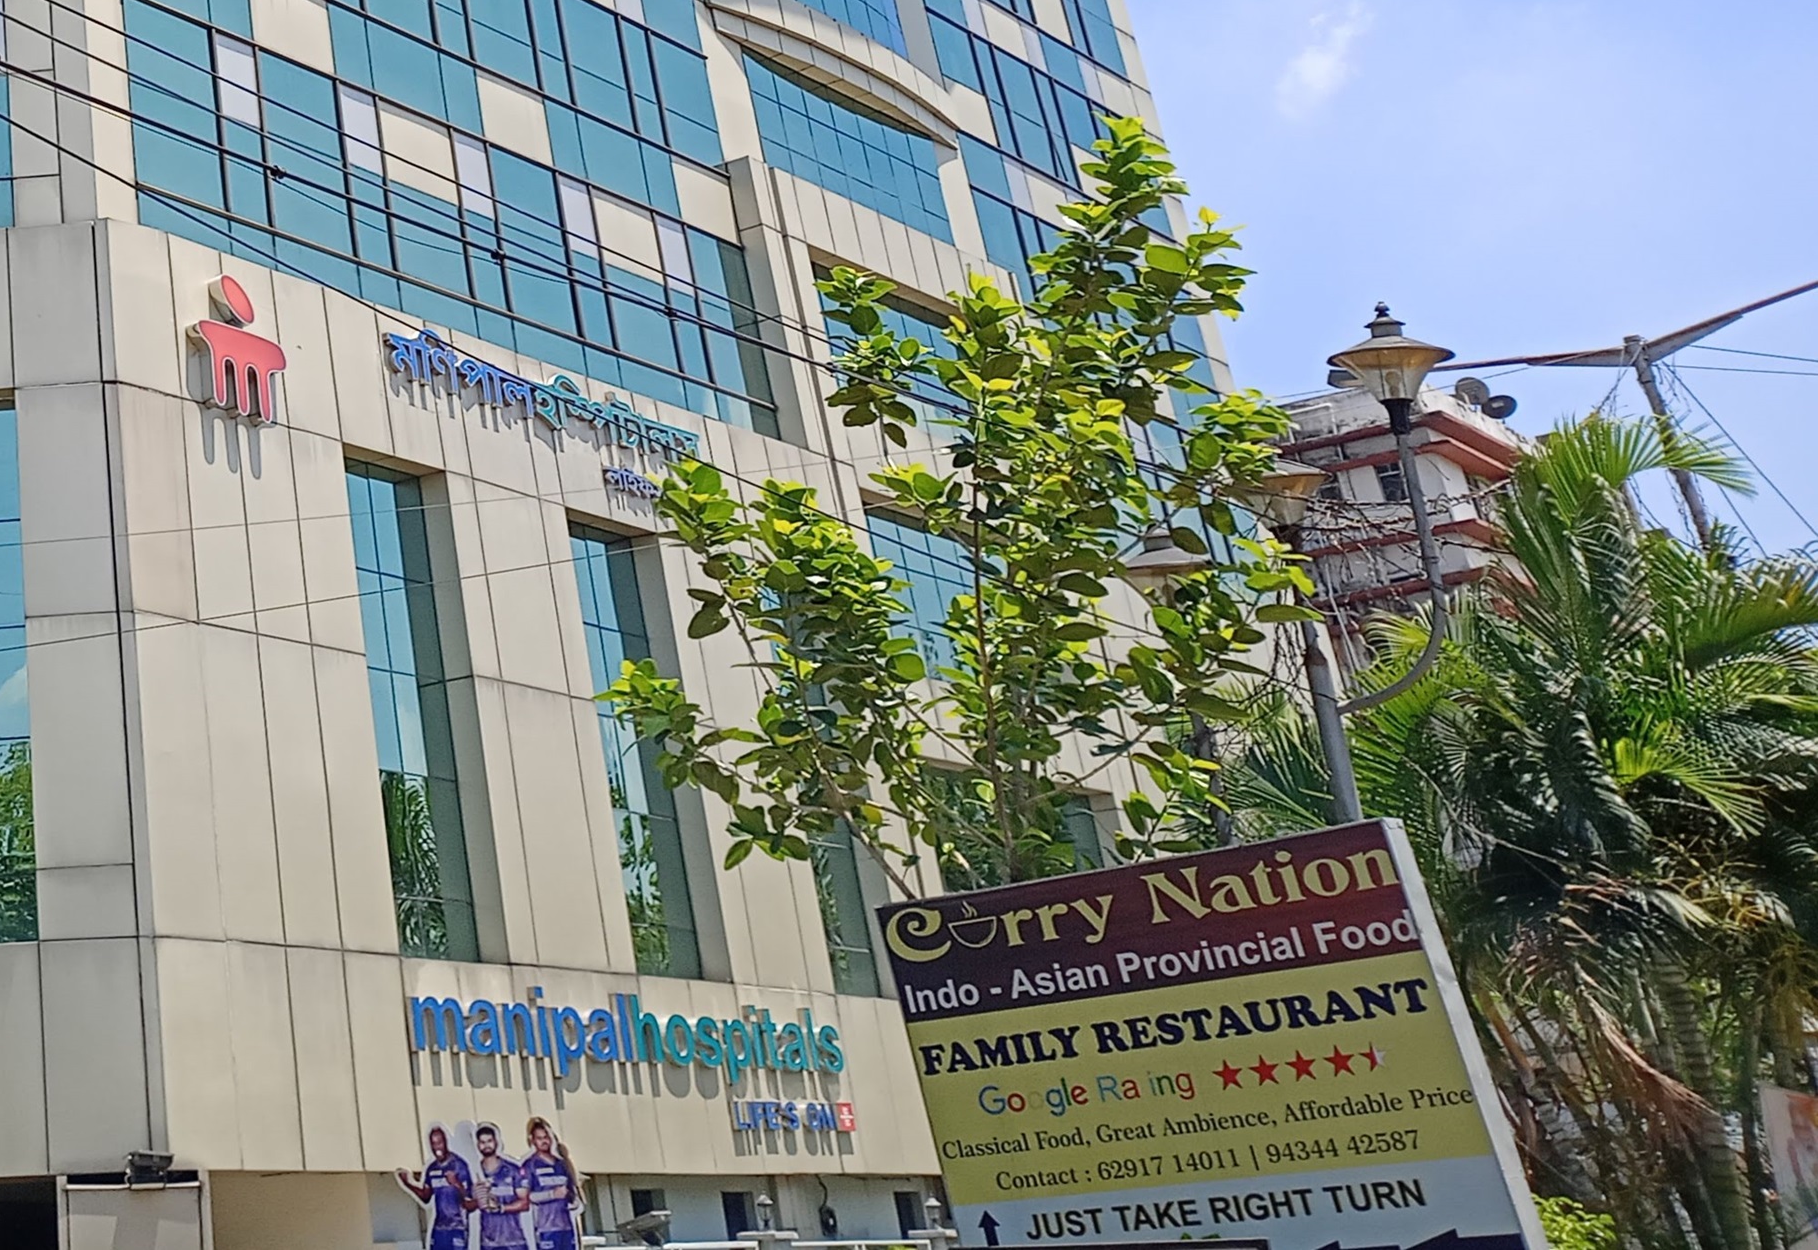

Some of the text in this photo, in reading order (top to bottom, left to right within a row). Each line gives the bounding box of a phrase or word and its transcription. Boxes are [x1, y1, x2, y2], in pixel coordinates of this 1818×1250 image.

[886, 849, 1400, 962] Curry Nation
[905, 979, 979, 1013] Indo
[1011, 963, 1109, 999] Asian
[1116, 927, 1305, 983] Provincial
[1312, 909, 1418, 954] Food
[918, 978, 1428, 1075] FAMILY RESTAURANT
[806, 1102, 838, 1131] ON
[942, 1087, 1473, 1159] Classical Food, Great Ambience, Affordable Price
[996, 1168, 1078, 1190] Contact
[1097, 1156, 1163, 1180] 62917
[1173, 1148, 1240, 1174] 14011
[1266, 1138, 1339, 1163] 94344
[1347, 1129, 1418, 1156] 42587
[1026, 1179, 1427, 1240] JUST TAKE RIGHT TURN
